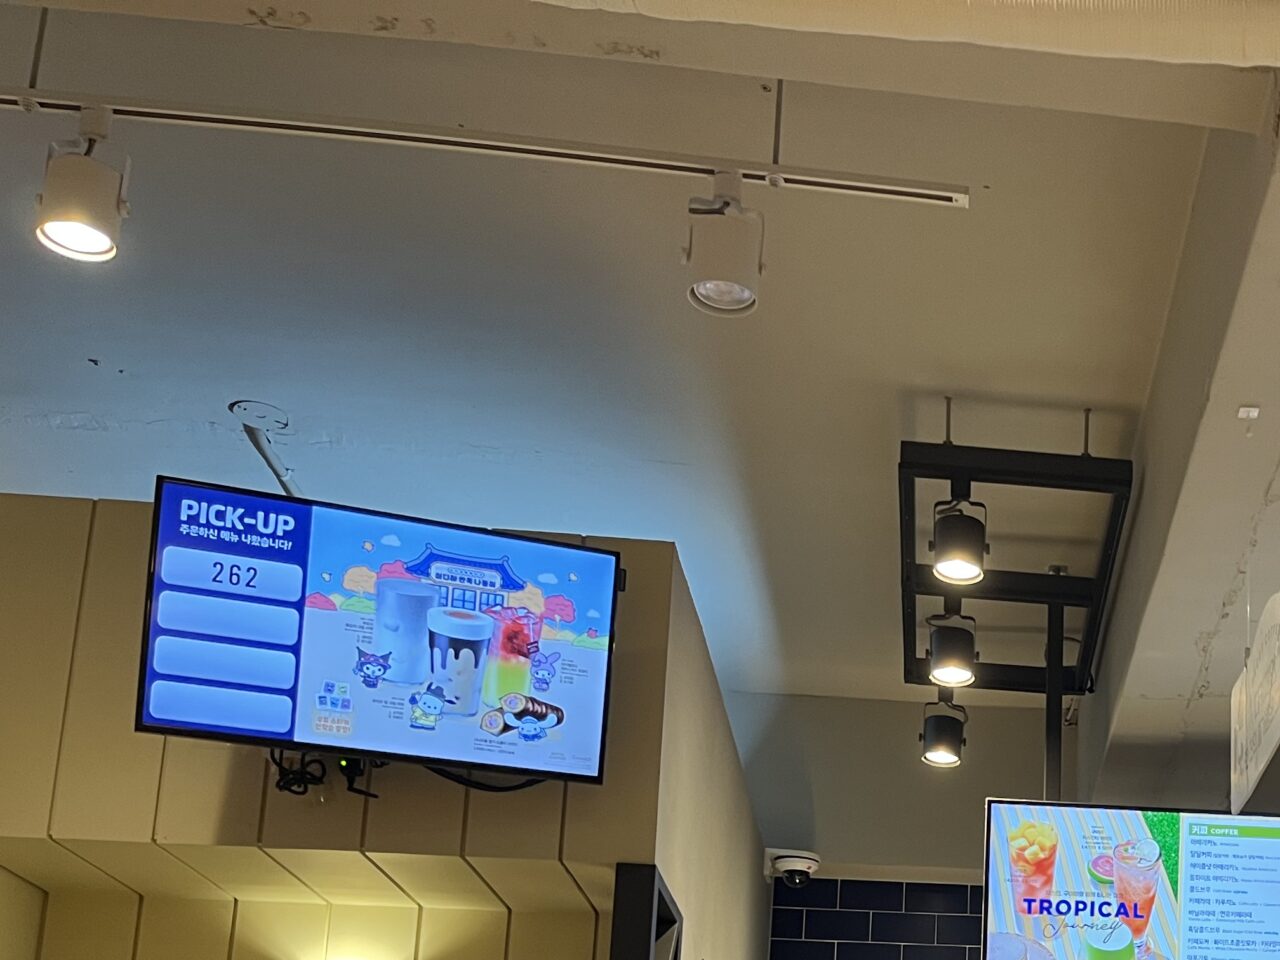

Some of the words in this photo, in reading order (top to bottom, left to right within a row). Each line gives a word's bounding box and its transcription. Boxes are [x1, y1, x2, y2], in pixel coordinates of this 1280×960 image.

[180, 499, 295, 536] PICK-UP
[180, 524, 218, 540] 주문하신
[220, 530, 240, 542] 메뉴
[241, 534, 293, 551] 나왔습니다!
[211, 561, 258, 588] 262
[1191, 825, 1208, 835] 커피
[1022, 897, 1145, 919] TROPICAL
[1042, 914, 1125, 944] Journey
